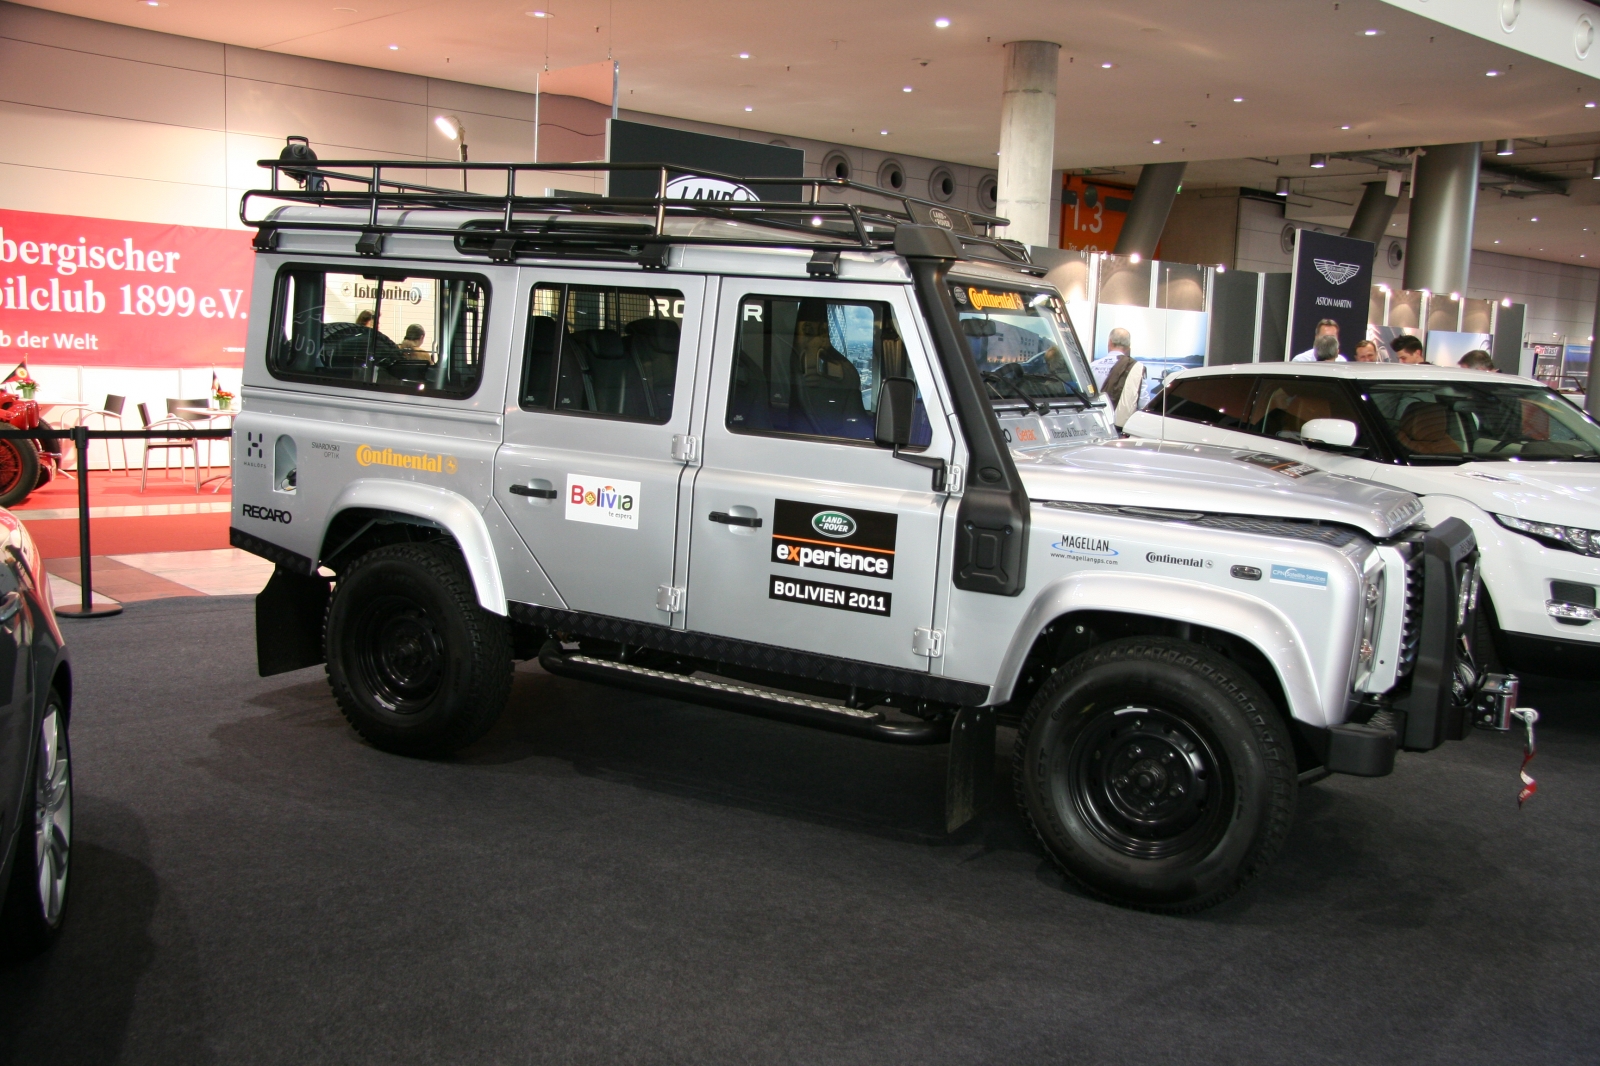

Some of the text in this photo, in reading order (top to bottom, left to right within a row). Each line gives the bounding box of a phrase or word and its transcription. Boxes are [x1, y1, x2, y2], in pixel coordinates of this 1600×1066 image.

[1070, 198, 1103, 234] 1.3
[0, 226, 181, 276] bergischer
[0, 275, 248, 320] ilclub 1899 e.V.
[968, 287, 1017, 310] Continental
[1315, 296, 1352, 309] ASTON MARTIN
[16, 330, 50, 349] der
[53, 332, 99, 351] Welt
[311, 441, 341, 452] SWAROVSKI
[323, 452, 341, 460] OPTIK
[355, 443, 442, 473] Continental
[571, 484, 634, 512] Bolivia
[242, 503, 293, 525] RECARO
[1061, 534, 1110, 553] MAGELLAN
[776, 543, 889, 575] experience
[1145, 551, 1204, 568] Continental
[774, 580, 887, 612] BOLIVIEN 2011
